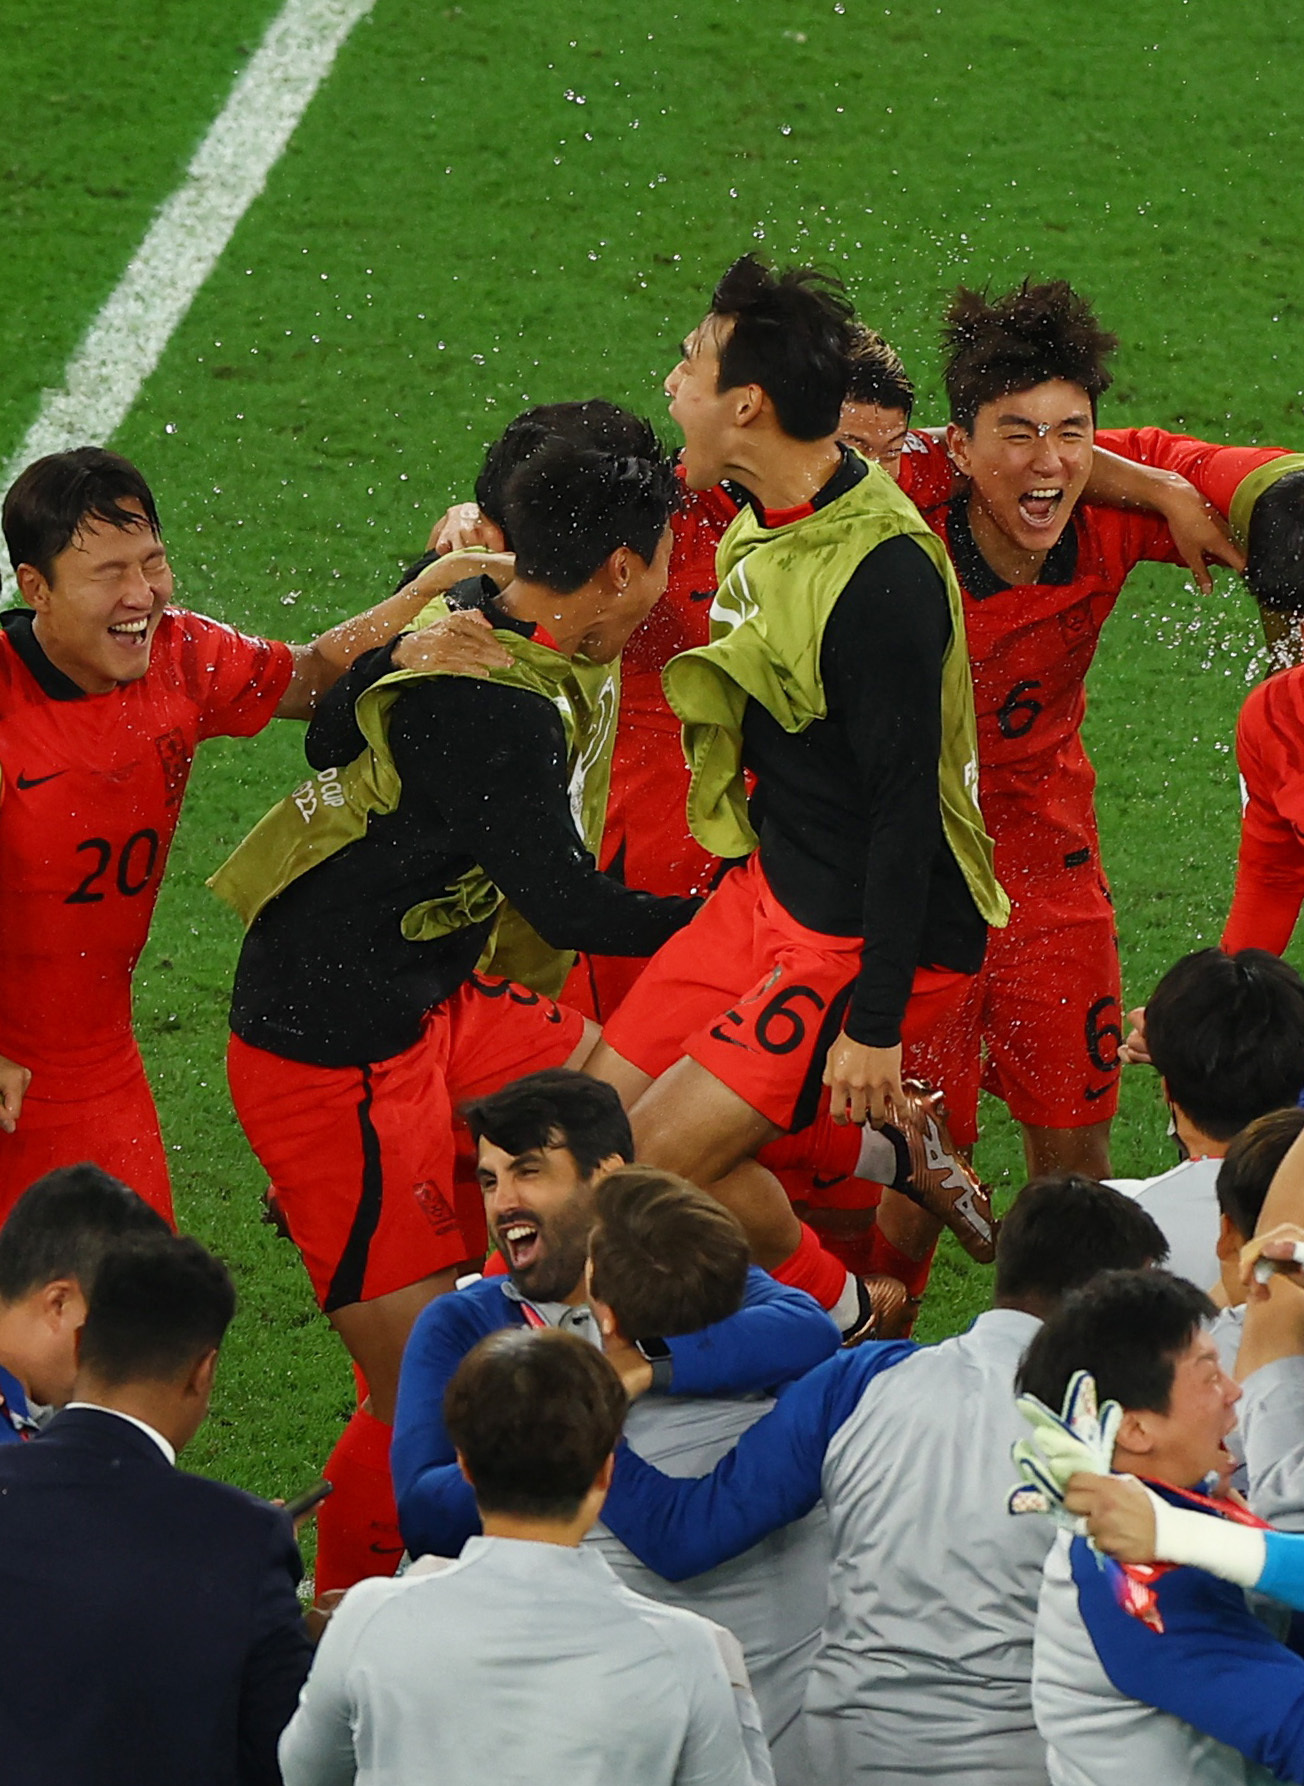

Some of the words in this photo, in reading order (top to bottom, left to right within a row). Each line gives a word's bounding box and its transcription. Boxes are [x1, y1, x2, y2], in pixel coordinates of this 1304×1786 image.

[998, 681, 1042, 739] 6
[292, 780, 317, 824] 022
[321, 782, 345, 807] CUP
[63, 828, 158, 904] 20
[728, 985, 826, 1055] 6
[1084, 995, 1122, 1072] 6
